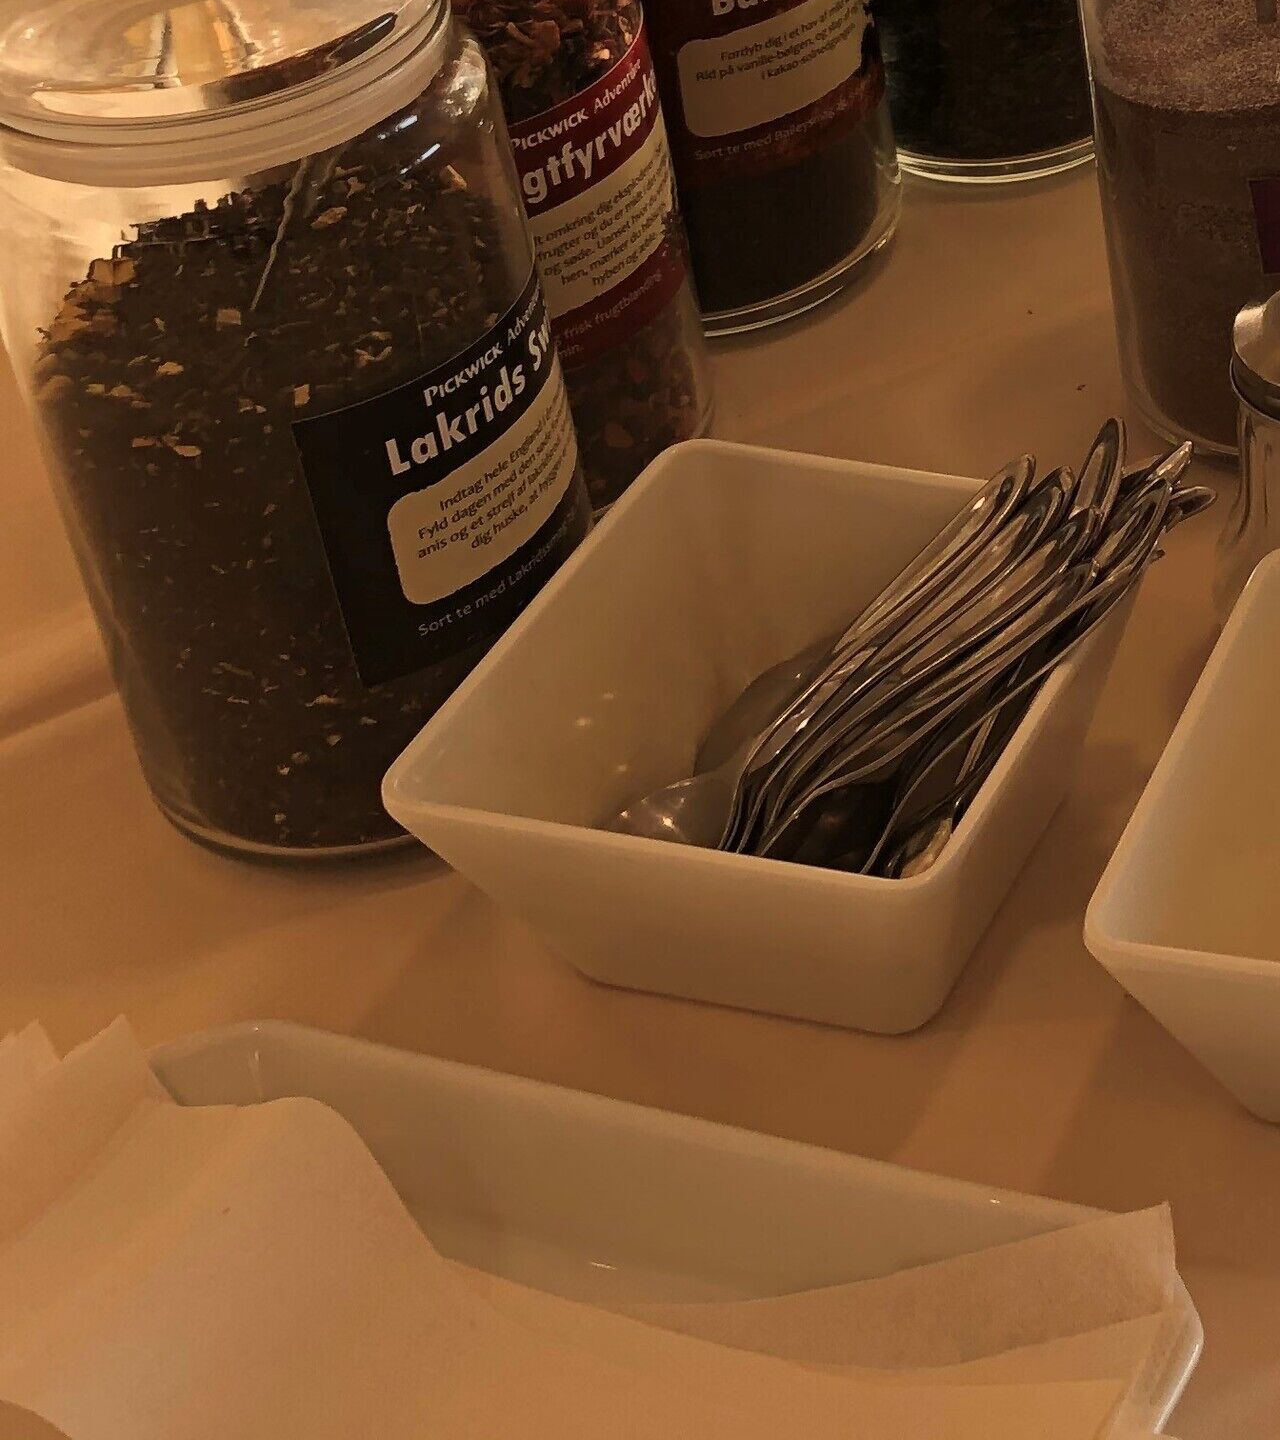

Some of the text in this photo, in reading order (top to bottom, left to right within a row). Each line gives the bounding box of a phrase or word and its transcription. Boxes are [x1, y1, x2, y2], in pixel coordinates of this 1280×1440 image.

[764, 33, 783, 50] dig
[718, 64, 735, 80] på
[767, 59, 799, 79] kakao
[510, 107, 590, 151] PICKWICK
[522, 68, 657, 204] gtfyrværk
[422, 340, 504, 407] PICKWICK
[384, 364, 527, 476] Lakrids
[417, 516, 448, 541] Fyld
[450, 493, 492, 524] dagen
[439, 480, 484, 511] Indtag
[417, 538, 448, 560] anis
[449, 526, 470, 544] og
[469, 515, 486, 531] et
[470, 530, 493, 551] dig
[417, 613, 454, 638] Sort
[456, 602, 473, 619] te
[474, 580, 507, 610] med
